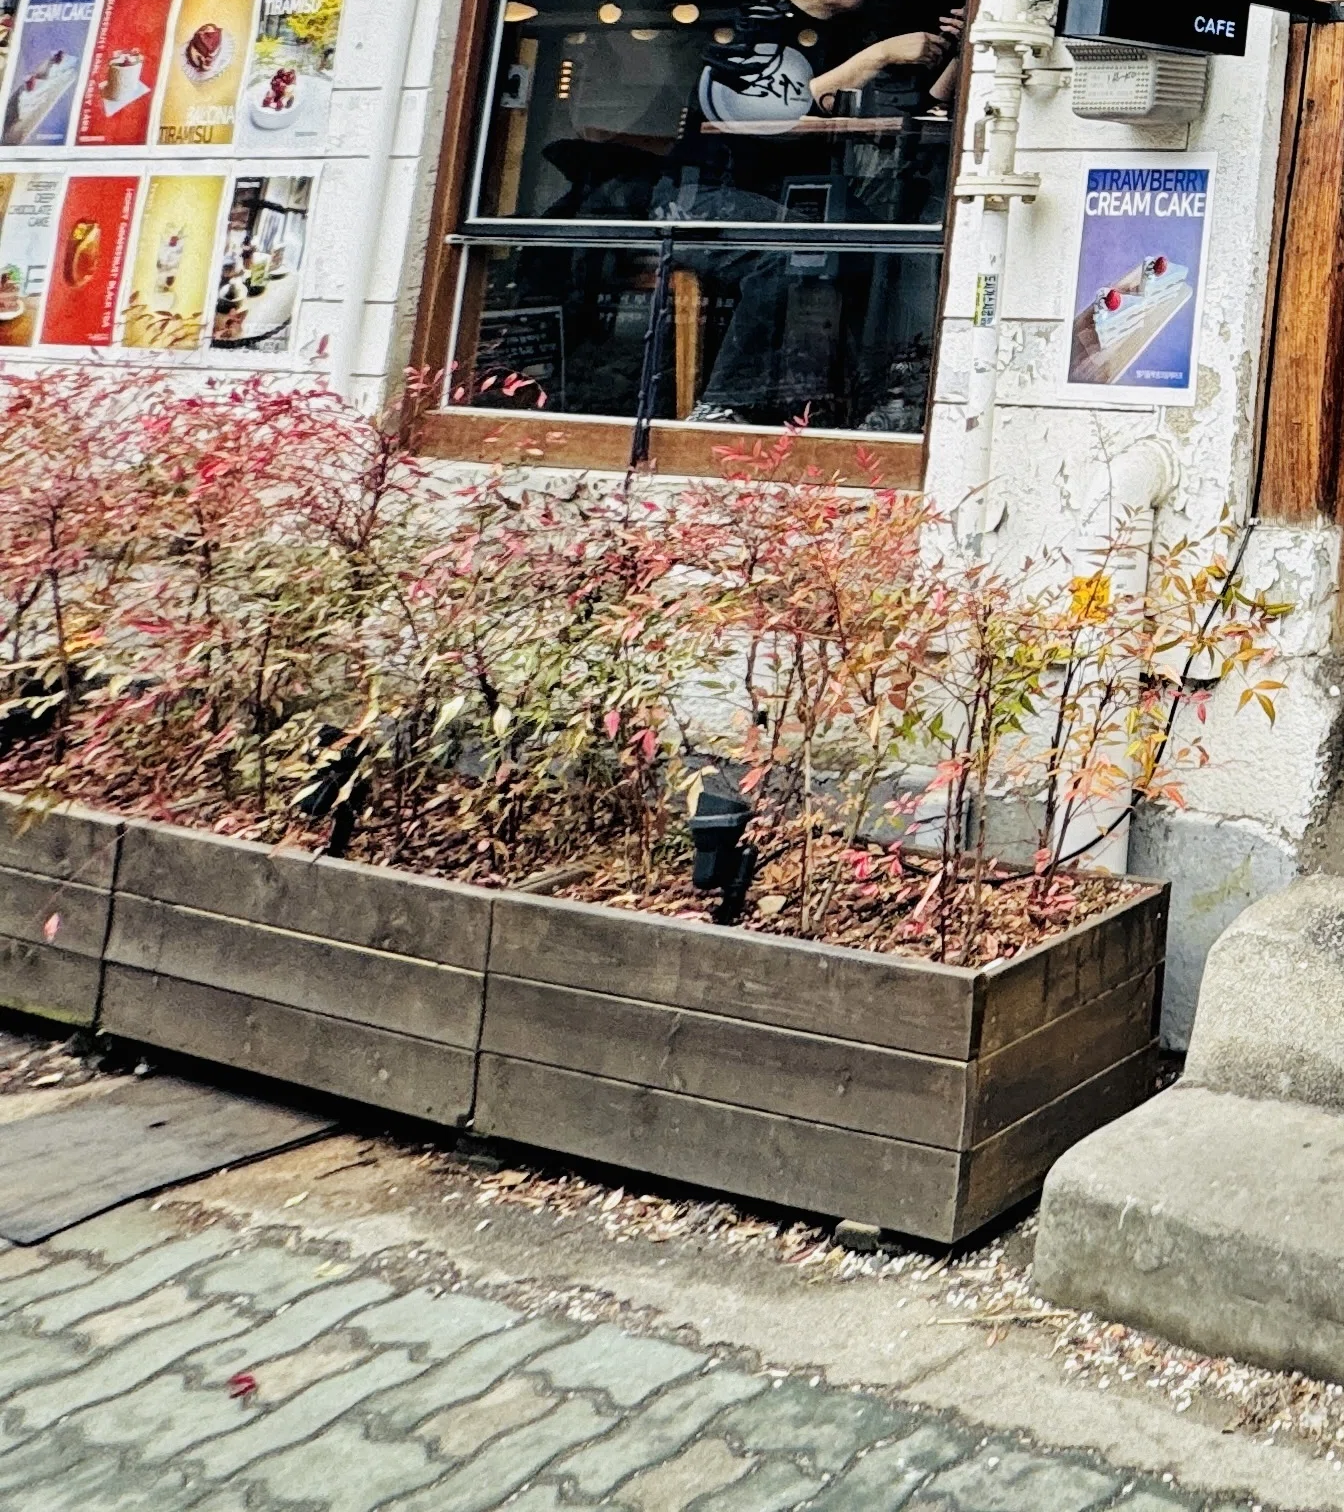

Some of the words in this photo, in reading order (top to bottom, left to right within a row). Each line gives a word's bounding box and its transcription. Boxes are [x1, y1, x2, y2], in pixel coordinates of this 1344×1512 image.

[24, 3, 61, 23] CREAM
[62, 2, 96, 21] CAKE
[1194, 15, 1236, 38] CAFE
[159, 125, 213, 144] TIRAMISU
[1087, 169, 1209, 192] STRAWBERRY
[1085, 191, 1150, 216] CREAM
[1154, 192, 1206, 217] CAKE
